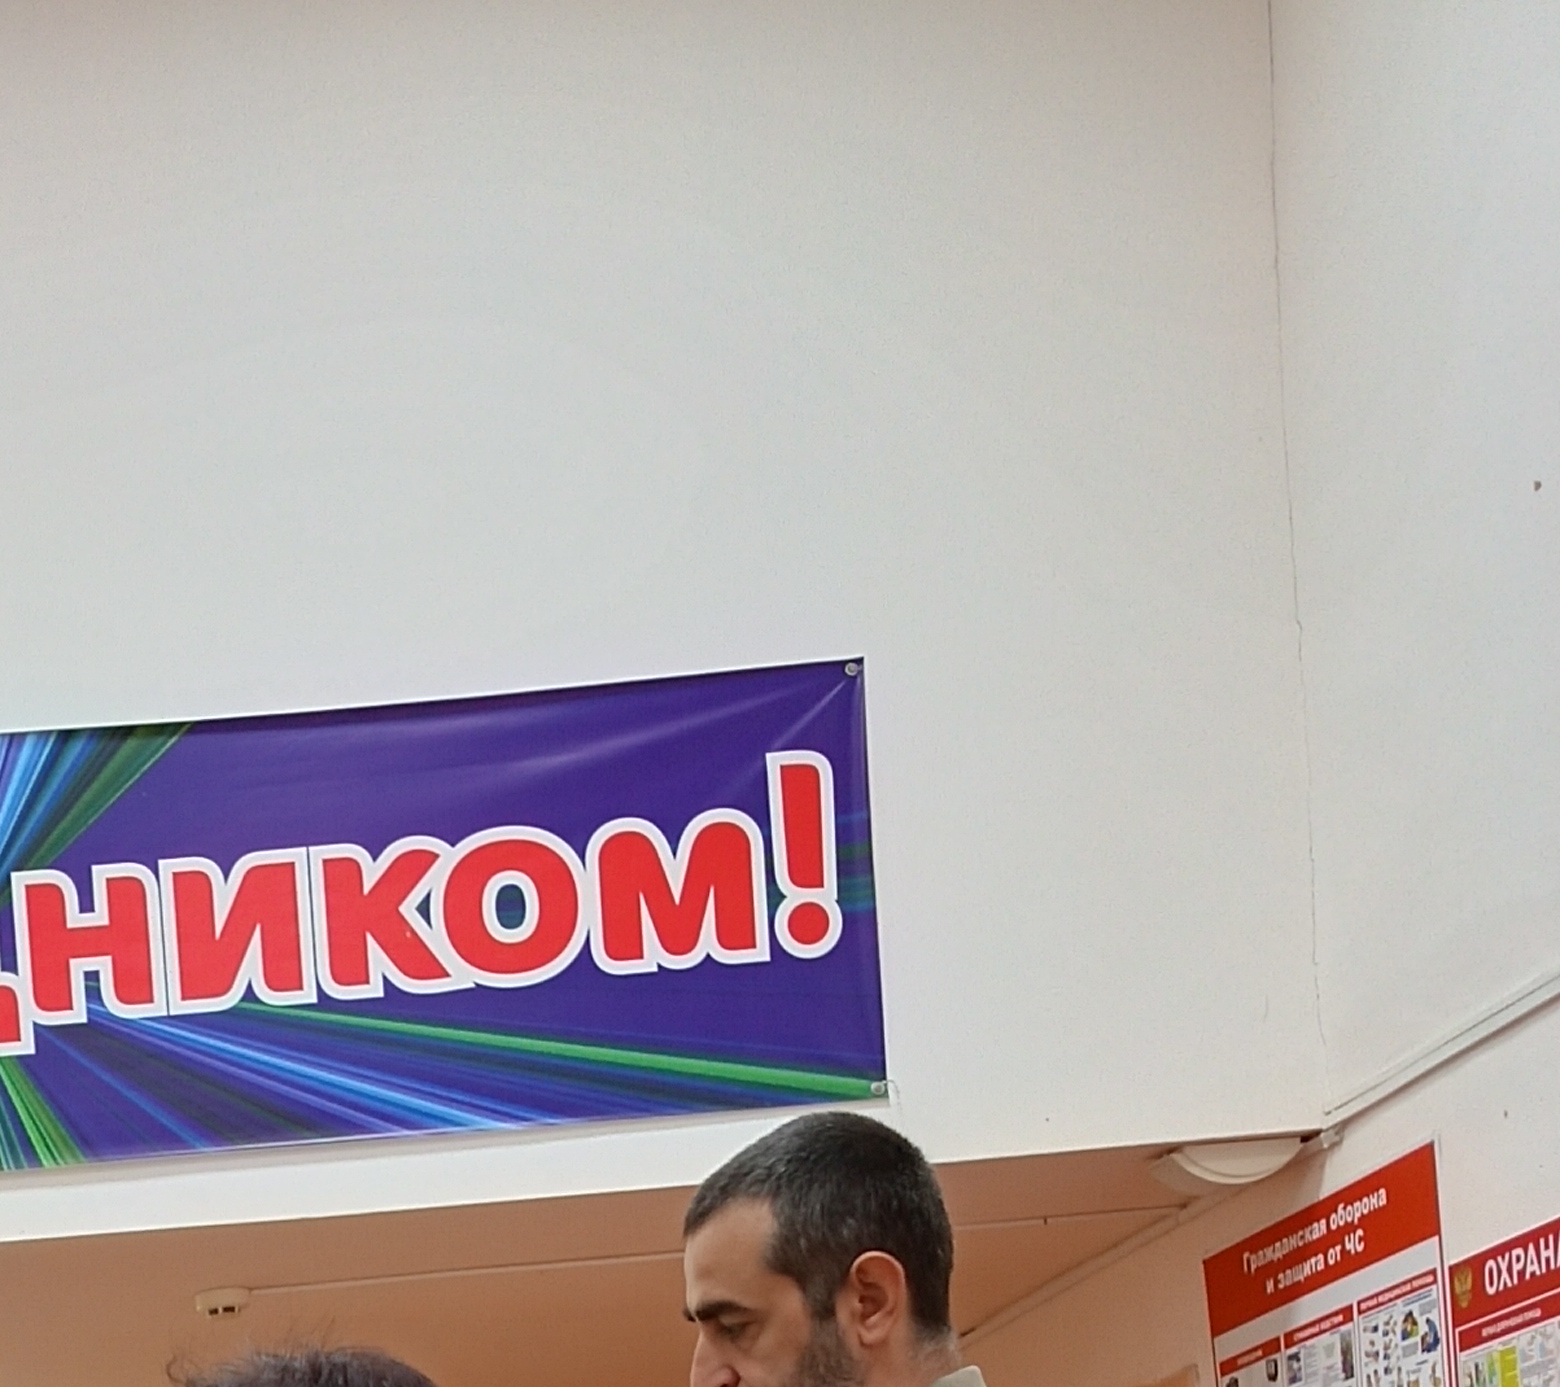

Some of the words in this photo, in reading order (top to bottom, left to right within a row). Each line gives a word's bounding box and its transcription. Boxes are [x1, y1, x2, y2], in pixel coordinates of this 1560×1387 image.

[1243, 1219, 1327, 1275] Гражданская
[1330, 1187, 1387, 1228] оборона
[1266, 1279, 1274, 1295] и
[1277, 1253, 1324, 1290] защита
[1327, 1244, 1341, 1265] от
[1345, 1229, 1365, 1254] ЧС
[1484, 1229, 1560, 1295] ОХРАН
